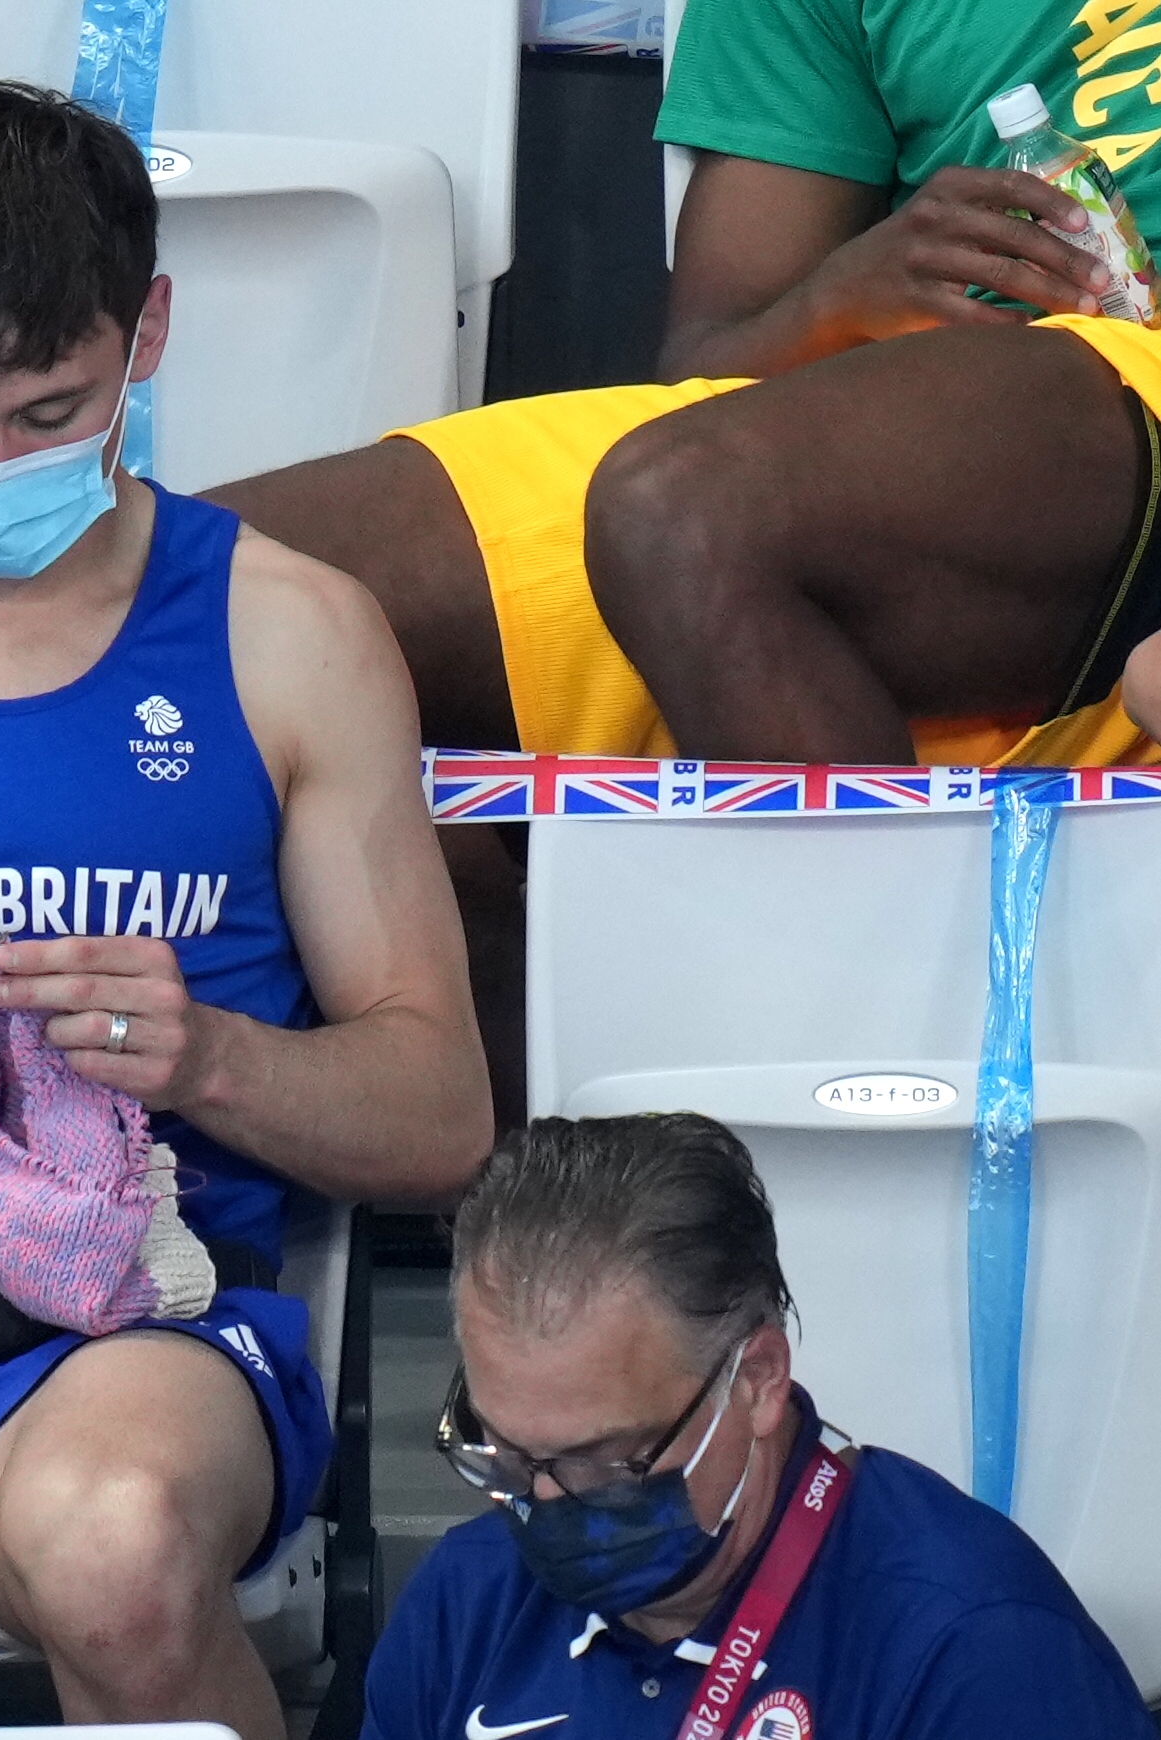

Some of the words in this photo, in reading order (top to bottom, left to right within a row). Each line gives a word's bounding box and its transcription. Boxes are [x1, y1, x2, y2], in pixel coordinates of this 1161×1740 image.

[128, 740, 170, 753] TEAM
[172, 741, 195, 754] GB
[671, 762, 698, 807] BR
[829, 1087, 941, 1103] A13-f-03
[707, 1625, 761, 1705] TOKYO
